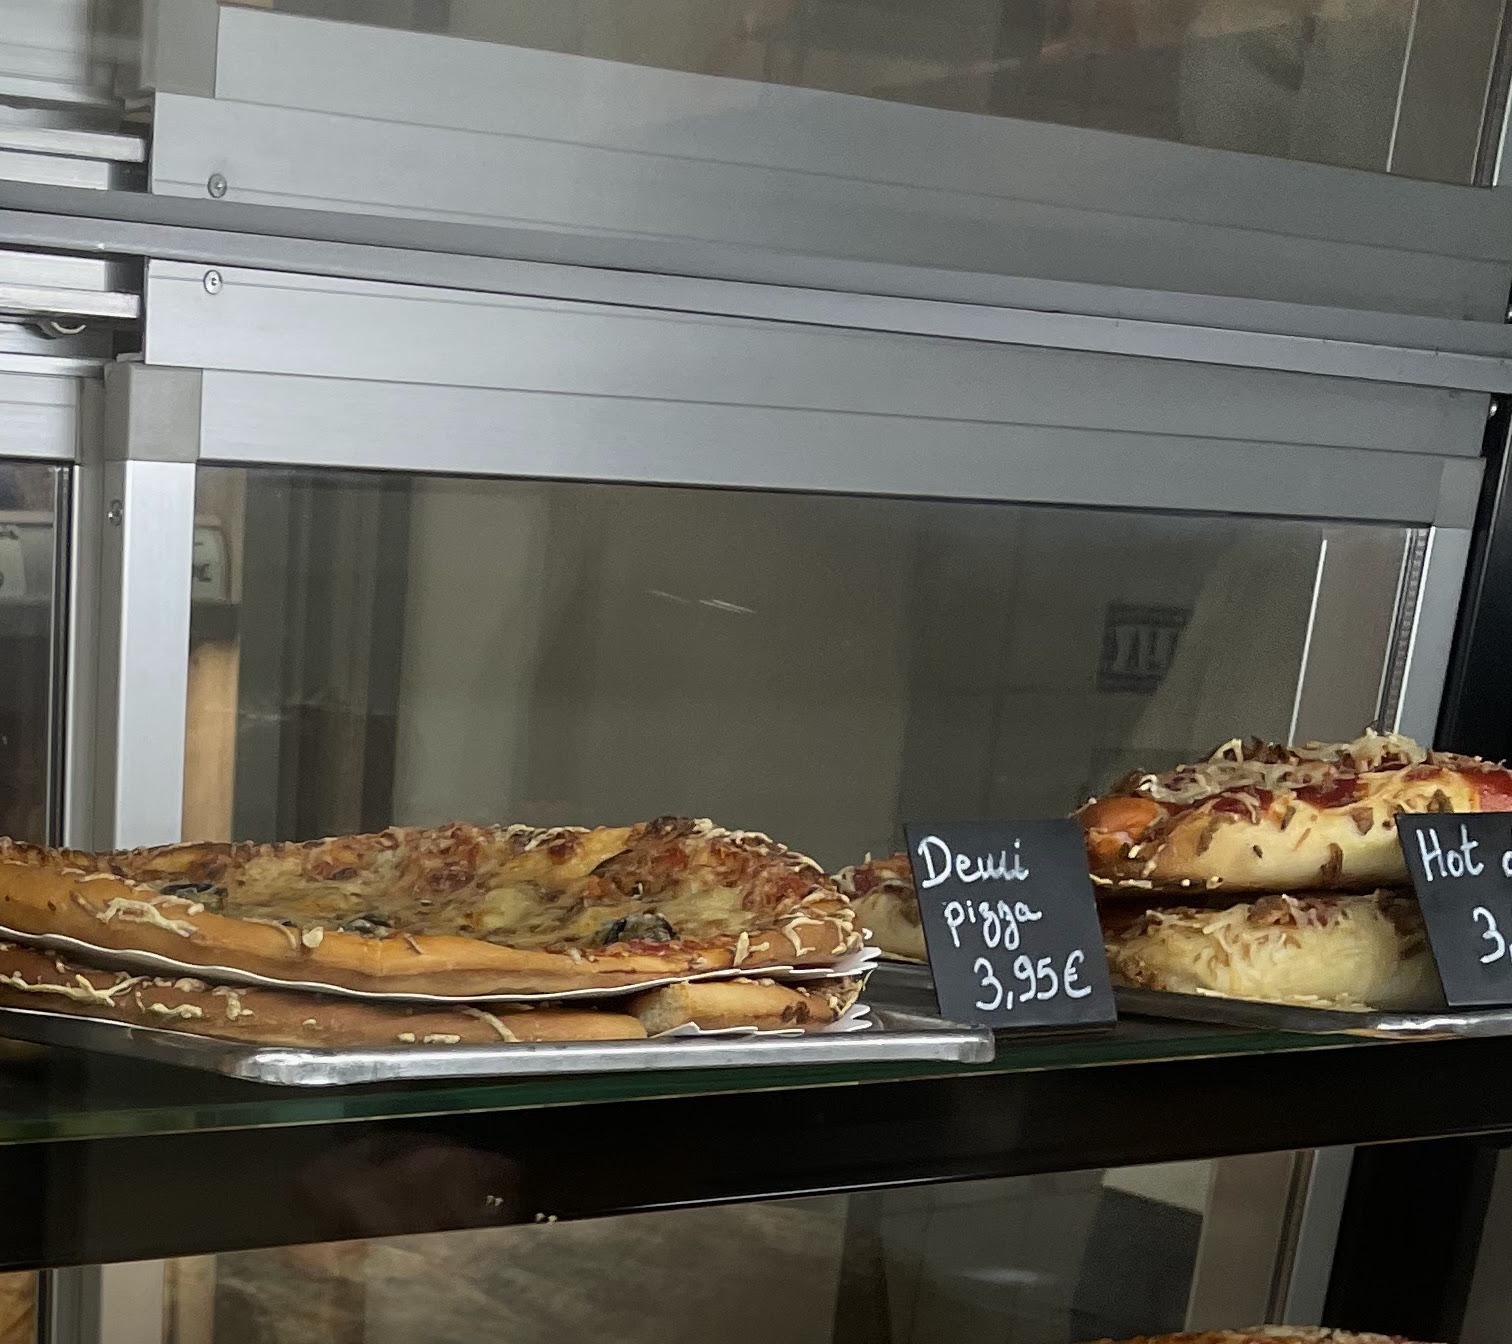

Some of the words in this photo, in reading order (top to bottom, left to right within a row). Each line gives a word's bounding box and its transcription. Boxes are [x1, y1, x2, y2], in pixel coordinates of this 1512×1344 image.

[918, 835, 1029, 888] Demi
[1416, 823, 1485, 882] Hot
[943, 900, 1042, 950] pizza
[973, 950, 1092, 1010] 3,95€
